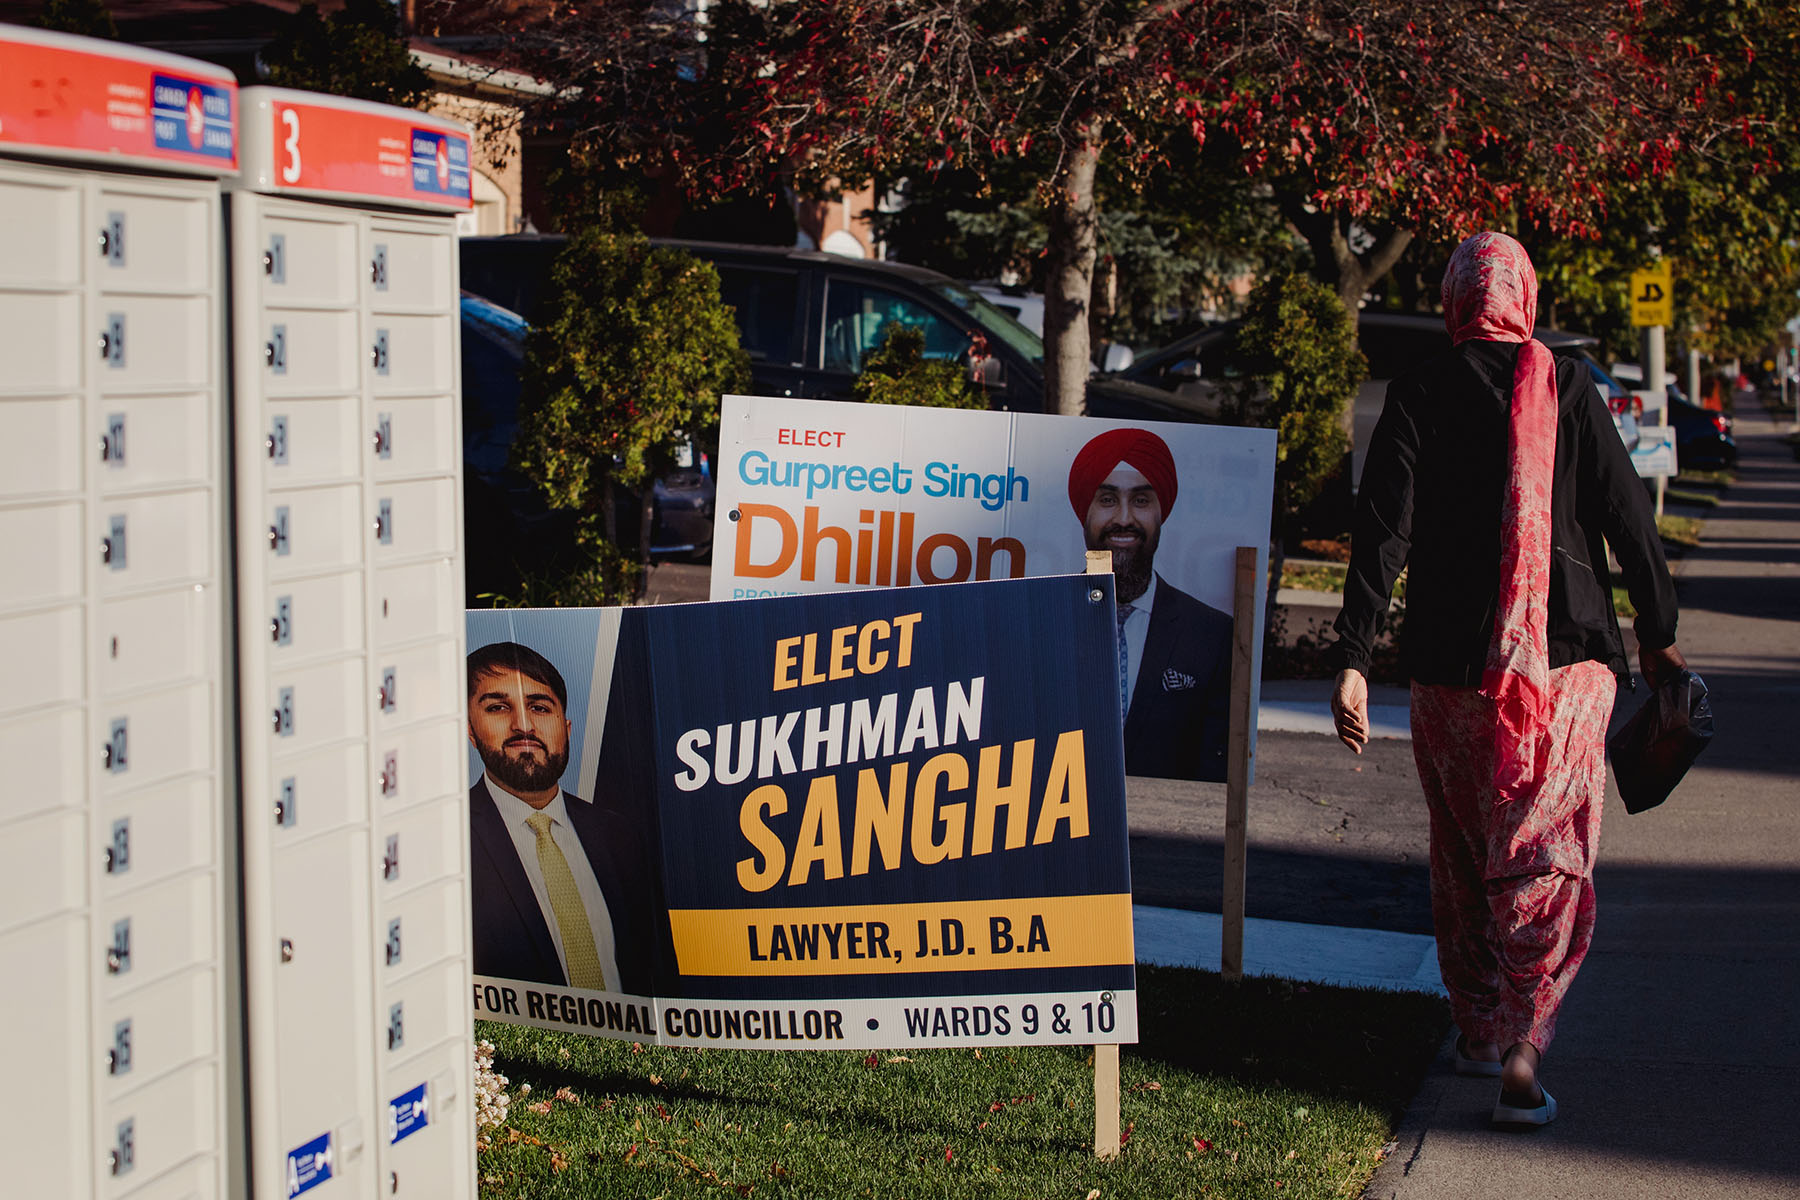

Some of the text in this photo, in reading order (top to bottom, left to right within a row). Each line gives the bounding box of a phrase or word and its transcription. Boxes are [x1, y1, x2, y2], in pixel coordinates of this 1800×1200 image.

[282, 109, 301, 183] 3
[778, 428, 846, 448] ELECT
[738, 450, 1030, 511] Gurpreet Singh
[734, 502, 1026, 588] Dhillon
[773, 612, 922, 691] ELECT
[674, 677, 985, 792] SUKHMAN
[736, 729, 1090, 893] SANGHA
[748, 914, 1051, 964] LAWYER, J.D. B.A
[473, 983, 1116, 1040] FOR REGIONAL COUNCILLOR WARDS 9 & 10
